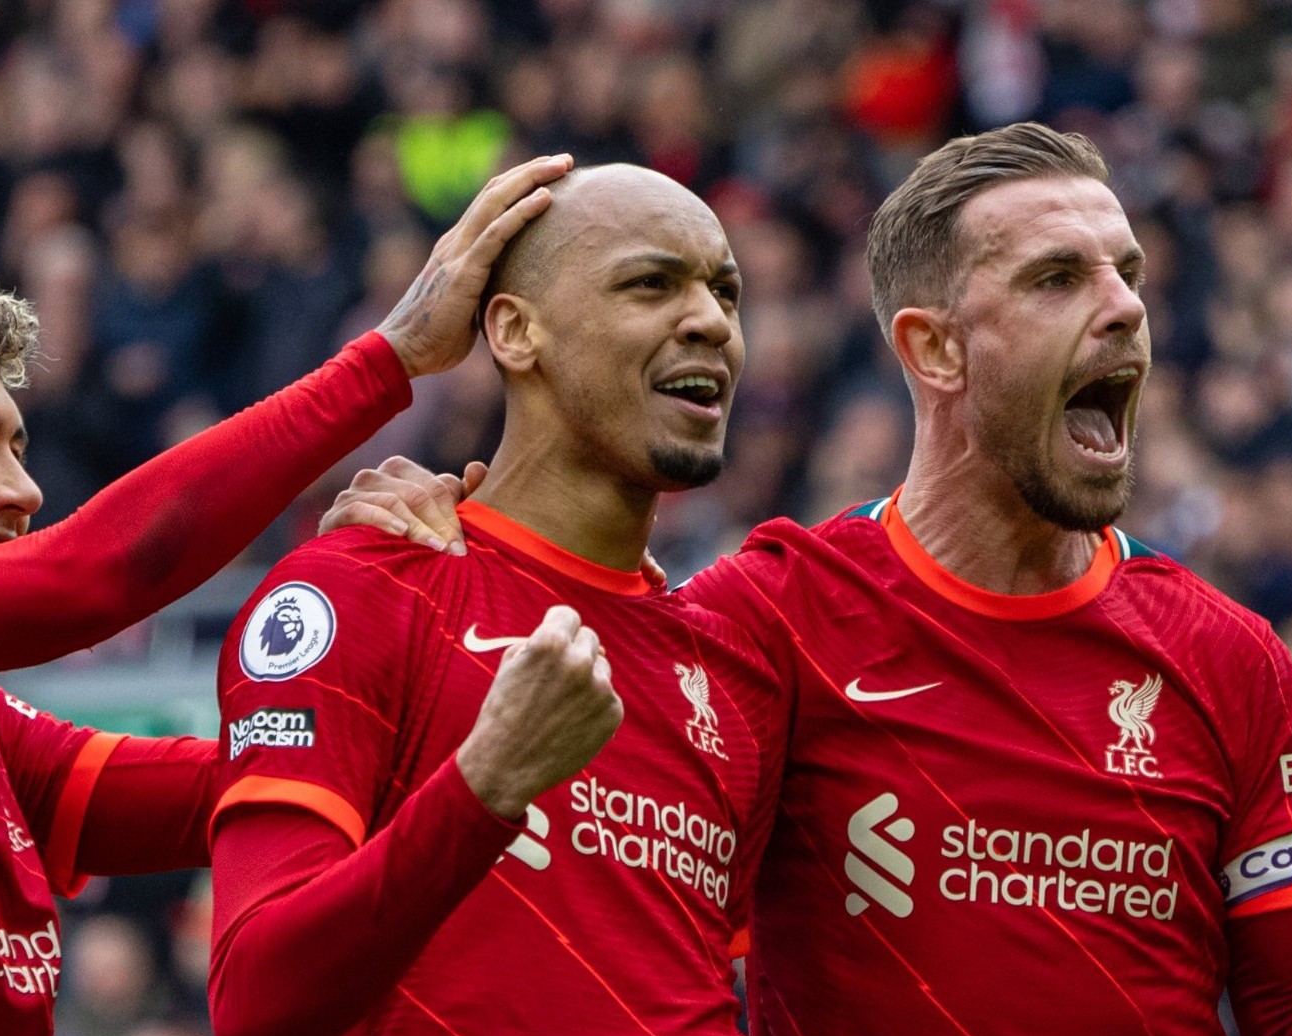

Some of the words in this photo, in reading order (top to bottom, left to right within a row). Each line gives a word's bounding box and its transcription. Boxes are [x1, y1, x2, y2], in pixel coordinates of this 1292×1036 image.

[268, 656, 299, 669] Premier
[299, 630, 319, 657] League
[229, 720, 250, 740] No
[250, 711, 305, 731] room
[248, 728, 314, 748] racism
[685, 724, 729, 761] L.F.C.
[1105, 750, 1164, 779] L.F.C.
[570, 776, 737, 866] standard
[571, 818, 729, 910] chartered
[940, 818, 1174, 878] standard
[939, 861, 1179, 921] chartered
